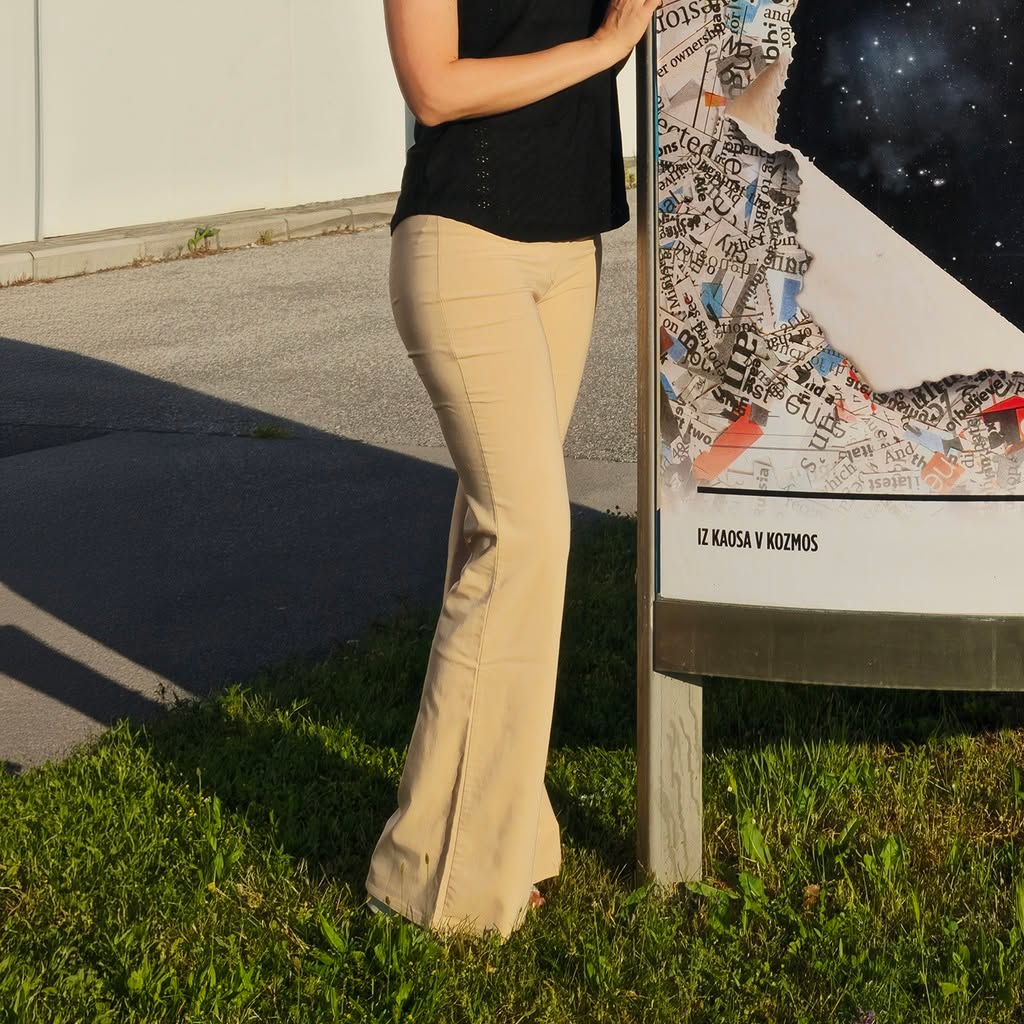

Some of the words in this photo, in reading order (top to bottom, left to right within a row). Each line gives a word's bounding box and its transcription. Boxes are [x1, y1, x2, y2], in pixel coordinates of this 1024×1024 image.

[763, 7, 792, 21] and
[670, 23, 726, 69] ownership
[662, 317, 679, 335] on
[953, 379, 1004, 422] believe
[686, 423, 712, 445] two
[884, 443, 915, 464] And
[697, 527, 709, 546] IZ
[712, 528, 752, 549] KAOSA
[755, 531, 764, 549] V
[766, 531, 819, 552] KOZMOS
